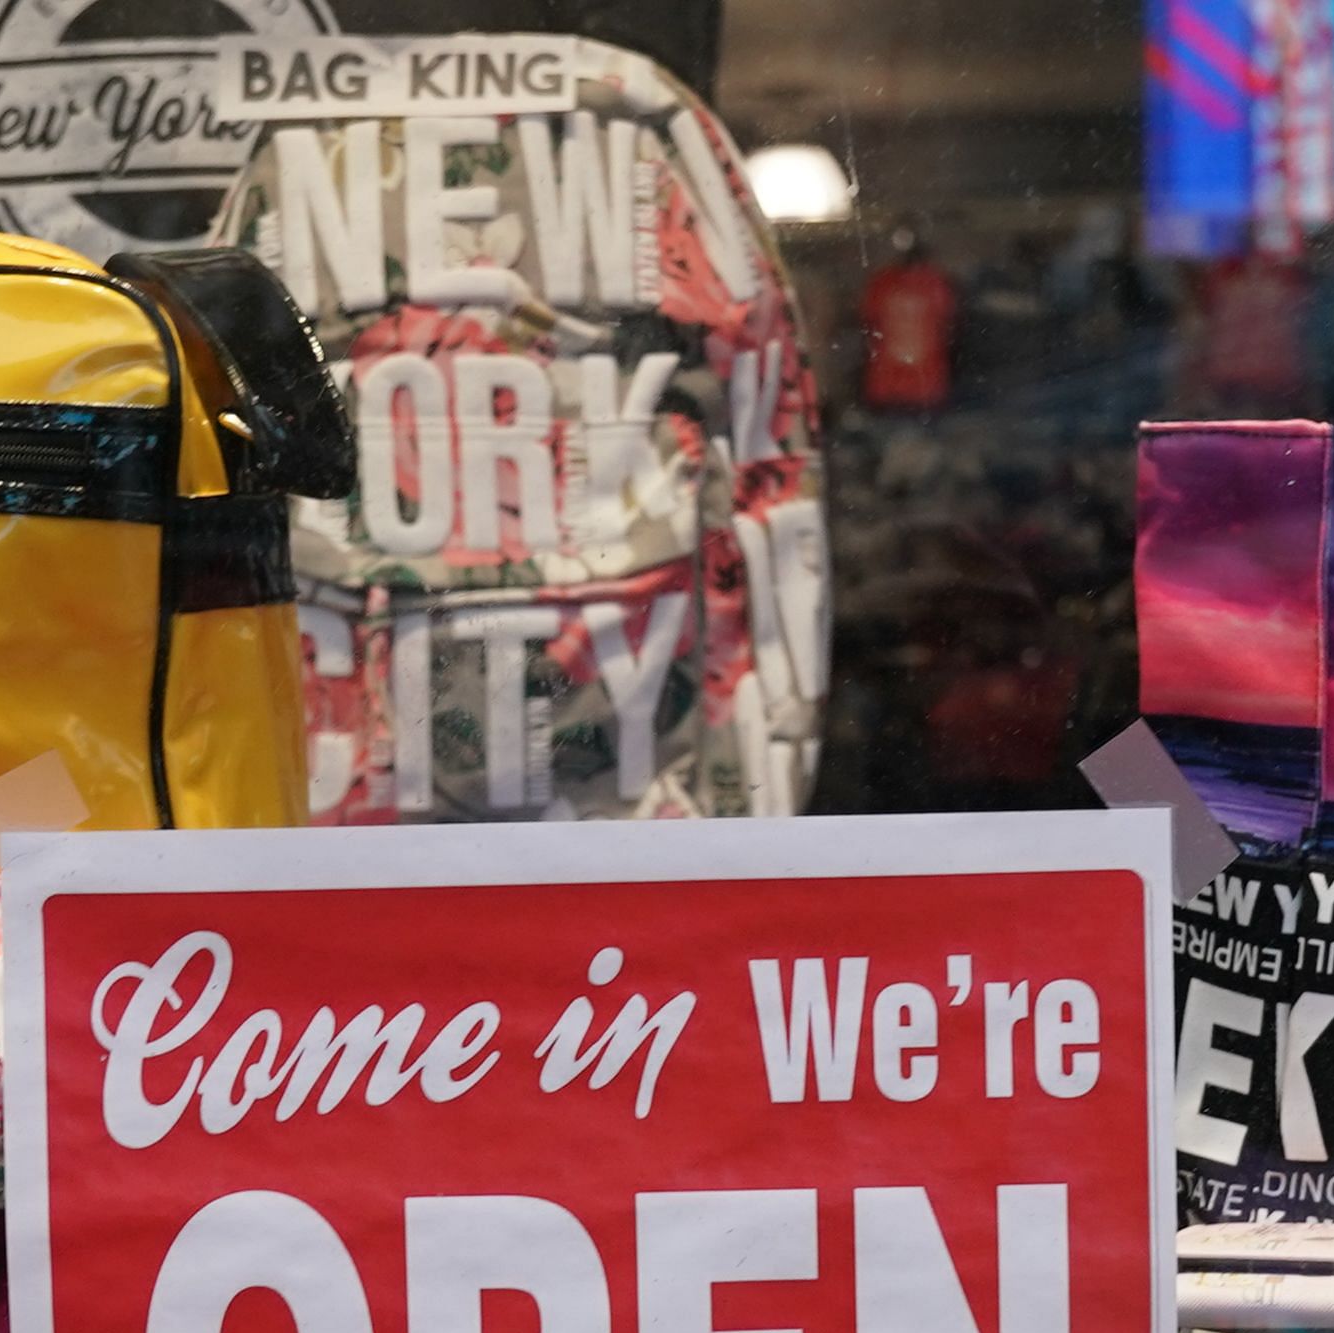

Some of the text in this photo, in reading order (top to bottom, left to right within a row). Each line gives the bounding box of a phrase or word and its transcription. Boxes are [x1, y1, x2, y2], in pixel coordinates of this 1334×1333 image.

[241, 50, 565, 102] BAG KING
[274, 112, 635, 314] NEW
[93, 931, 1101, 1148] Come in We're
